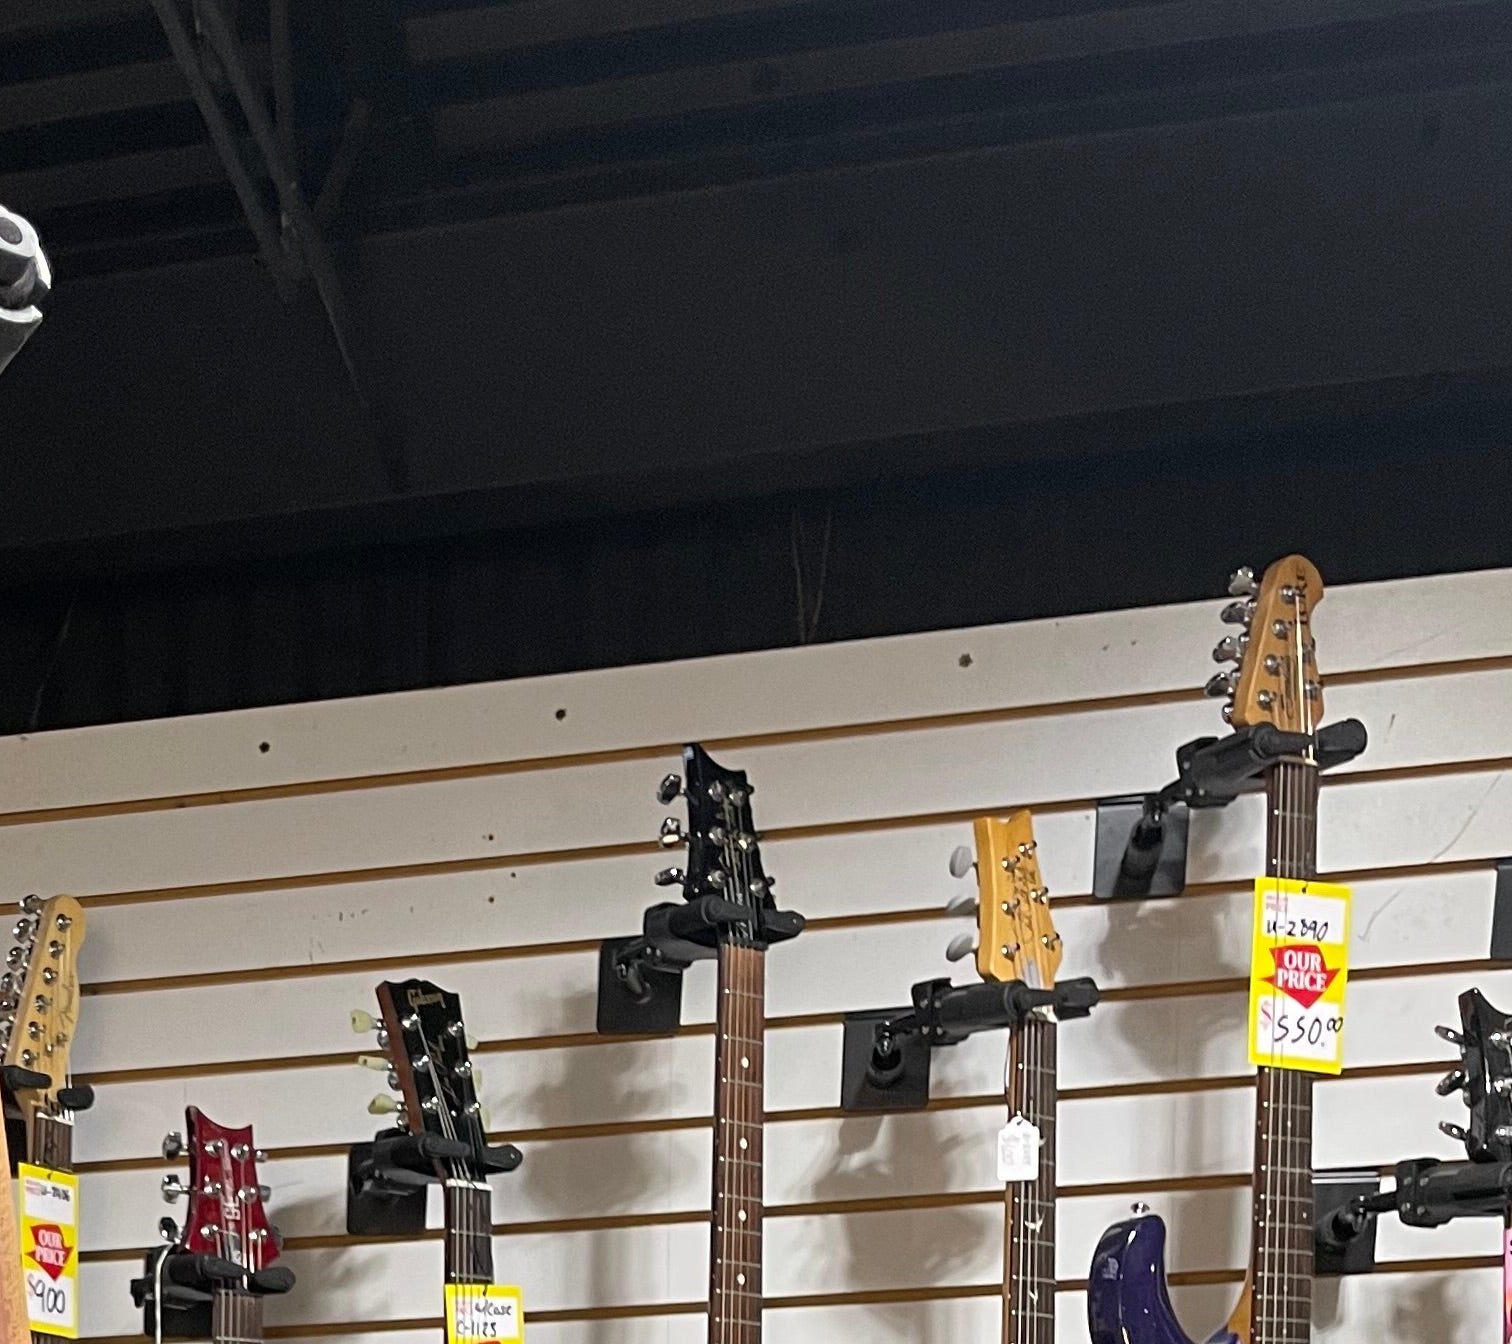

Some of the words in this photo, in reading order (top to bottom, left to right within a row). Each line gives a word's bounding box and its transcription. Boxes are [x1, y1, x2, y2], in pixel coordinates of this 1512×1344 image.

[1283, 949, 1322, 972] OUR
[1276, 968, 1328, 993] PRICE
[38, 1229, 63, 1248] OUR
[35, 1245, 66, 1267] PRICE
